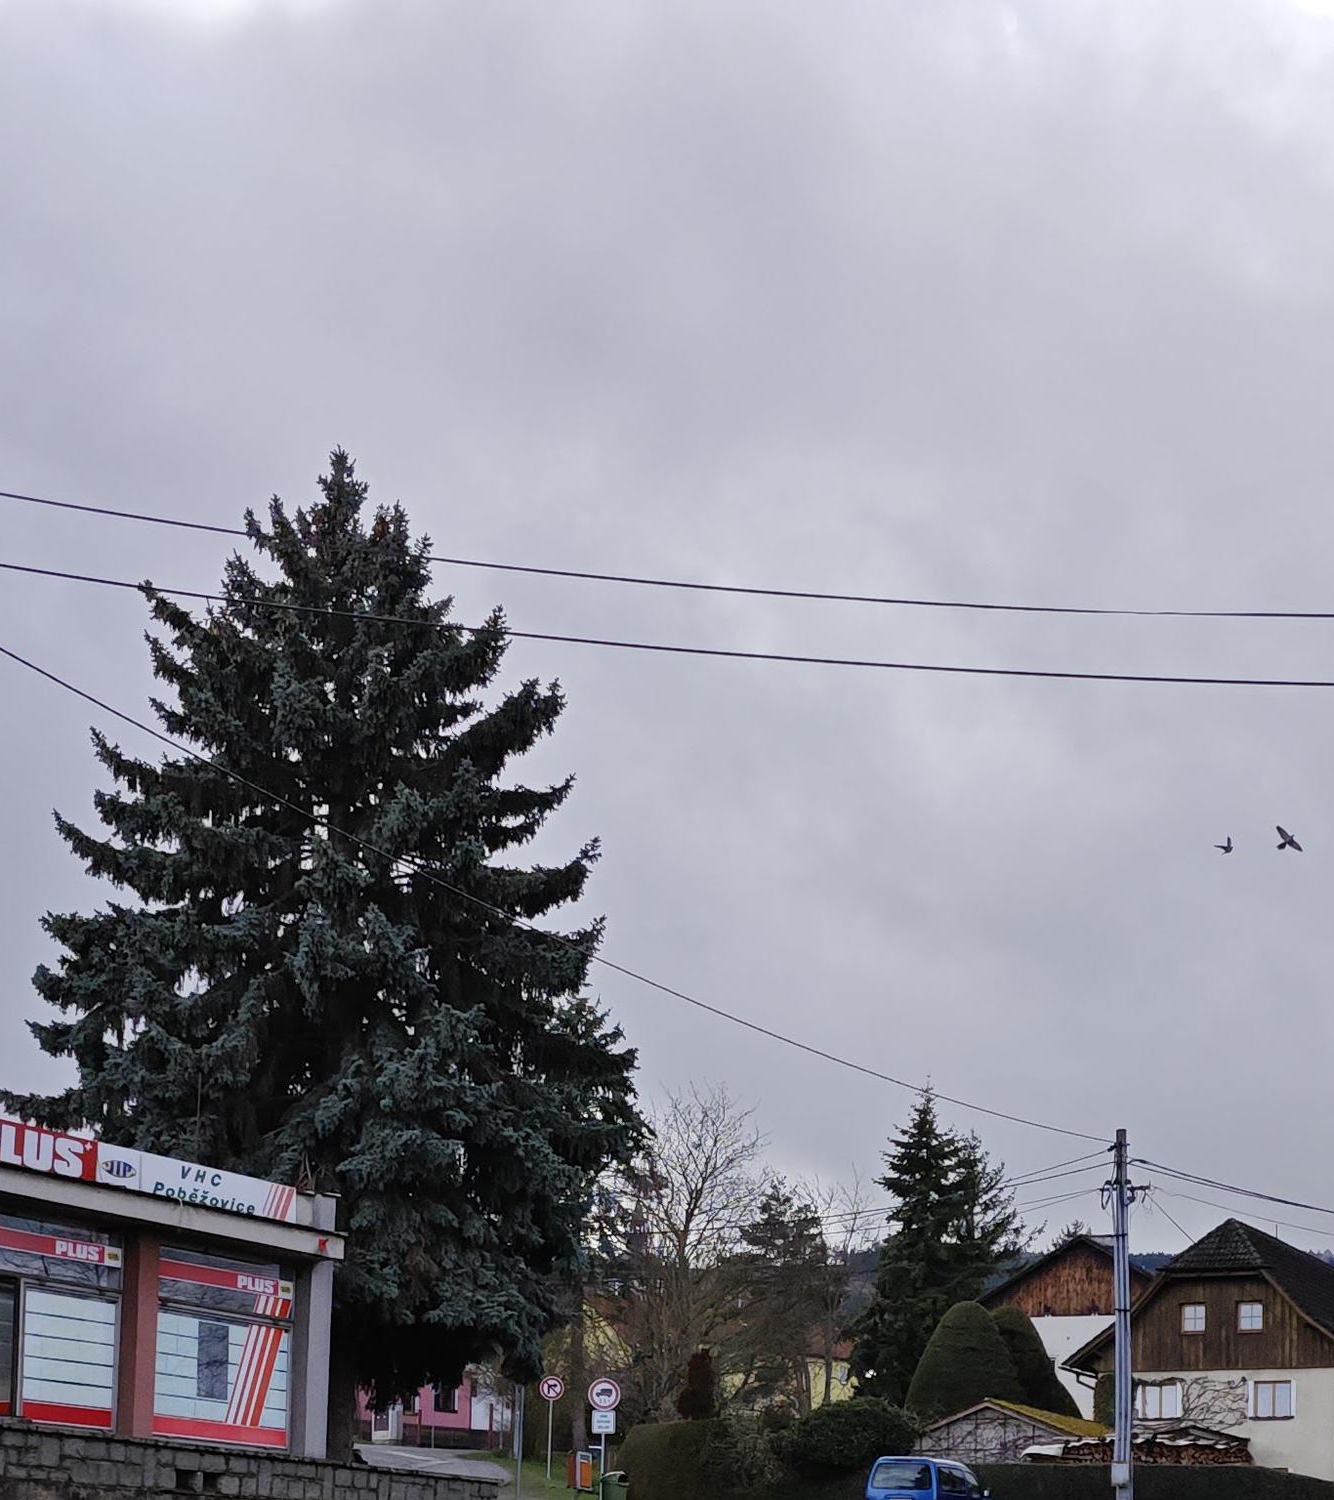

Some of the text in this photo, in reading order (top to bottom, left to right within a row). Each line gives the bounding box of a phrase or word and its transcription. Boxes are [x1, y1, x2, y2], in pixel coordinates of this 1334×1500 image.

[180, 1164, 223, 1186] VHC
[54, 1240, 101, 1262] PLUS
[235, 1274, 275, 1295] PLUS
